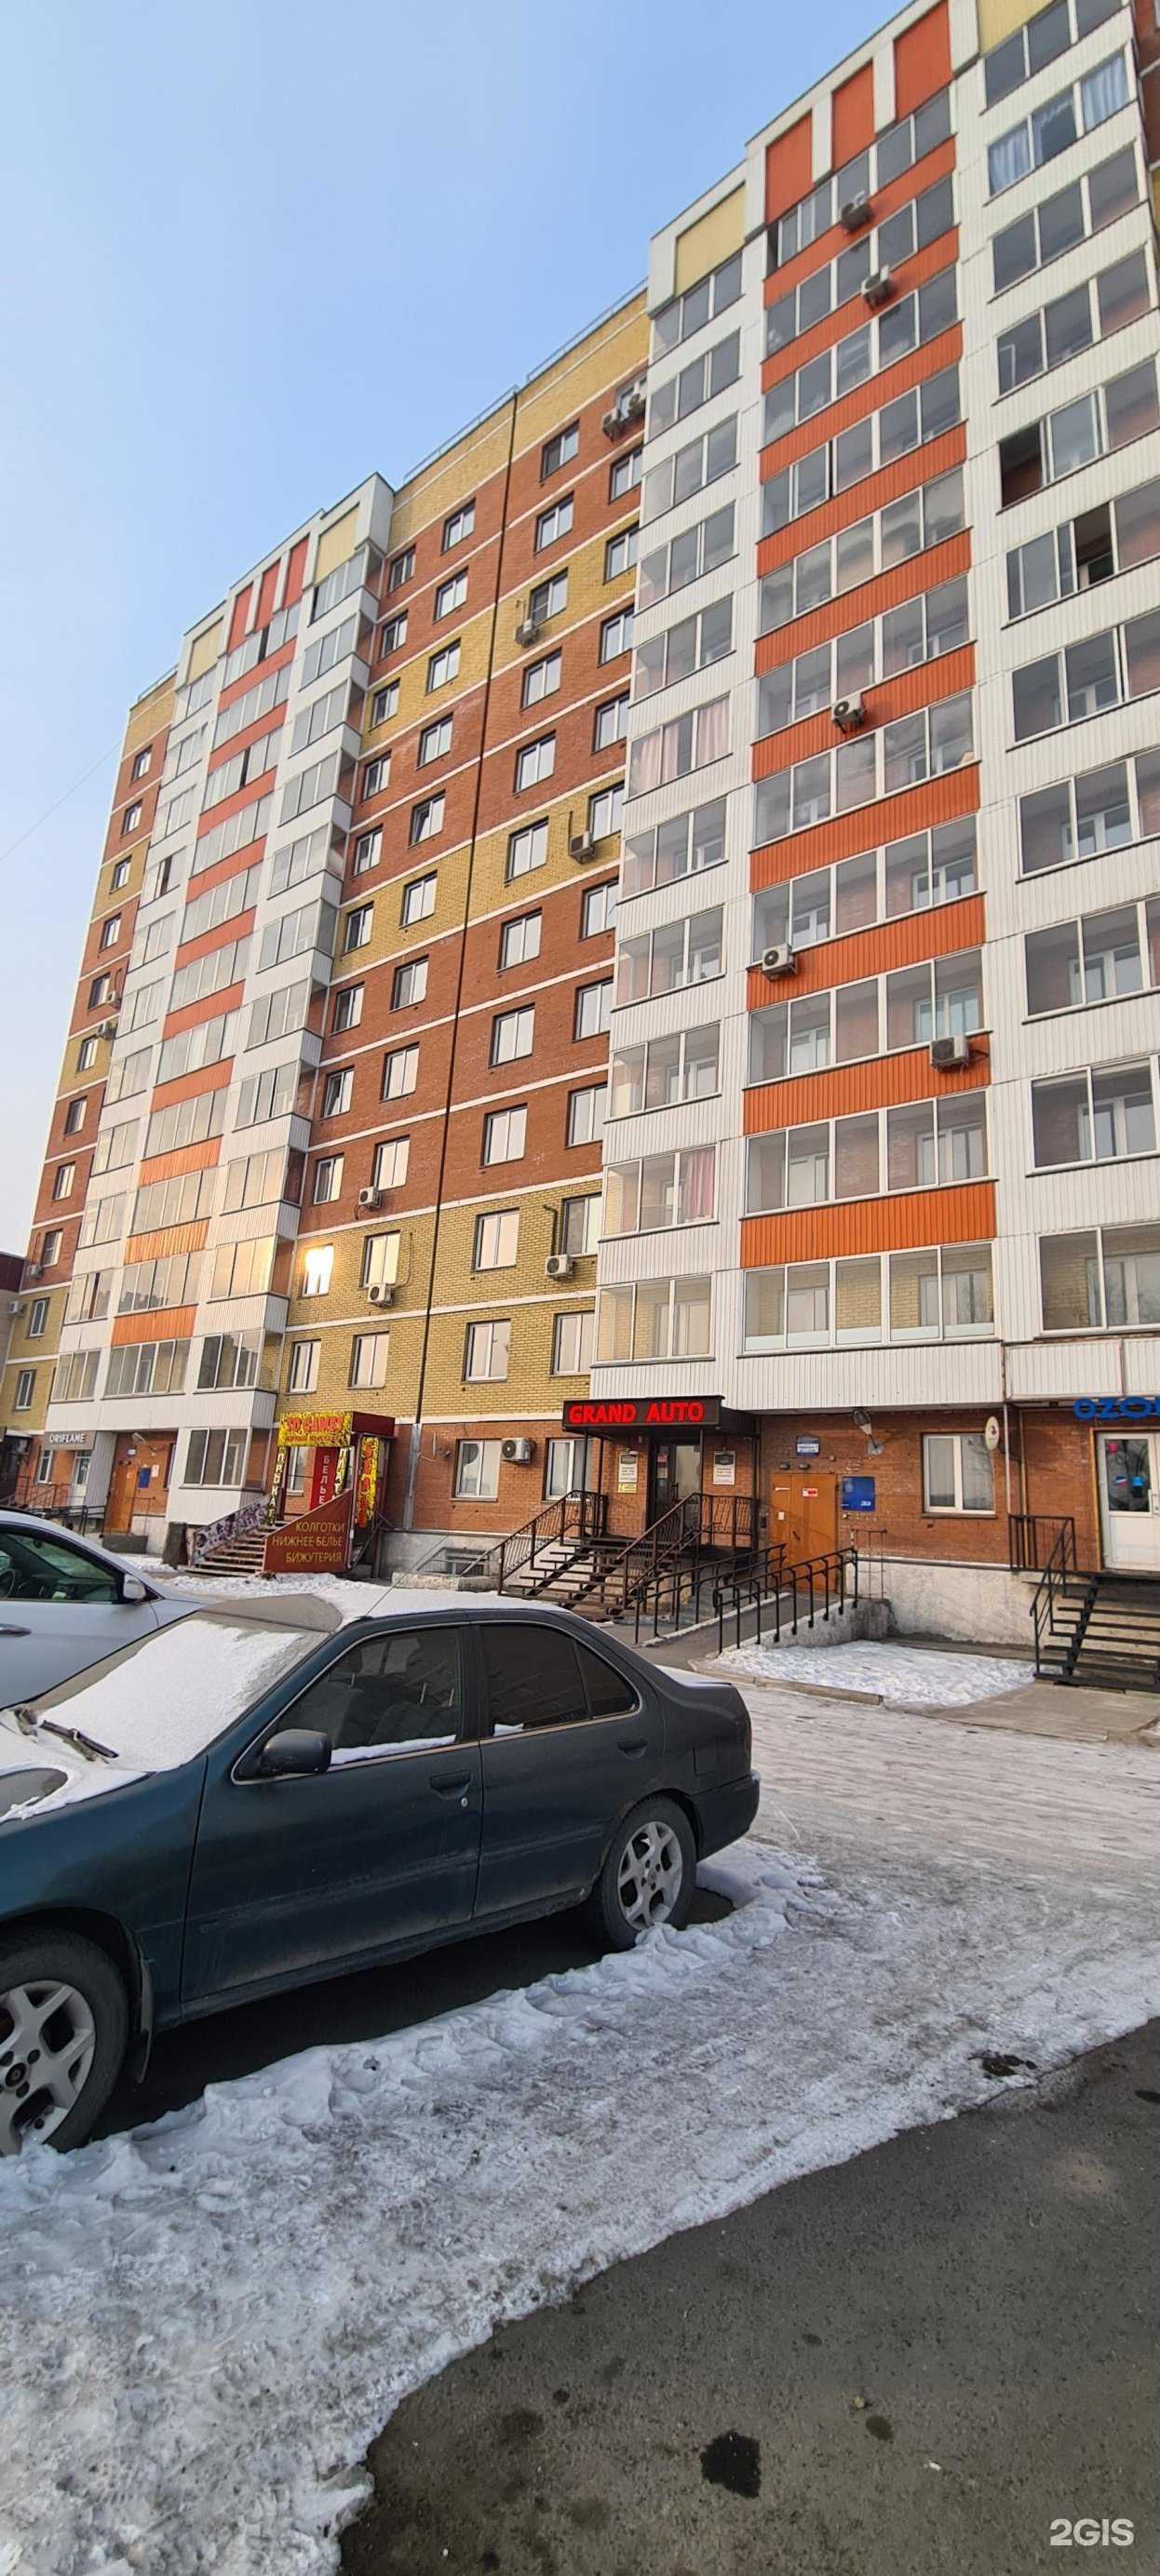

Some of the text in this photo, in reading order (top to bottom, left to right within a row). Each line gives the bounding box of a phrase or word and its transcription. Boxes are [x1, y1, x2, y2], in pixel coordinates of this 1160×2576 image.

[569, 1401, 704, 1424] GRAND AUTO
[1073, 1396, 1160, 1420] OZO
[48, 1433, 86, 1443] ORIFLAME
[318, 1455, 330, 1505] БЕЛЬЕ
[295, 1521, 344, 1533] КОЛГОТКИ
[272, 1536, 343, 1547] НИЖНЕЕ БЕЛЬЕ
[286, 1551, 342, 1563] БИЖУТЕРИЯ
